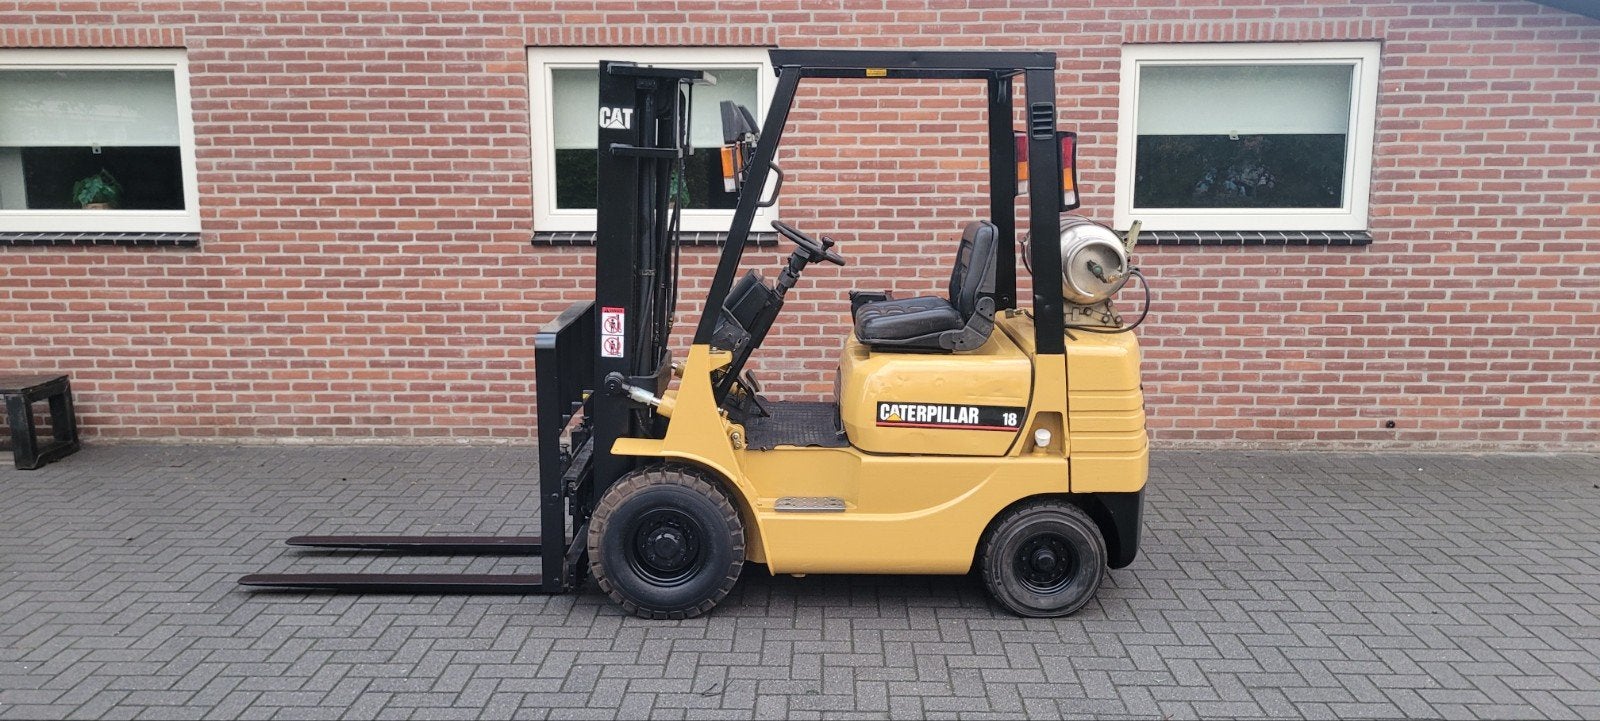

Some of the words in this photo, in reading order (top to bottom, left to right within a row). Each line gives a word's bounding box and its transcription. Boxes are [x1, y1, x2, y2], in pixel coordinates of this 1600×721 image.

[599, 106, 633, 129] CAT
[880, 403, 979, 424] CATERPILLAR
[1002, 412, 1017, 426] 18
